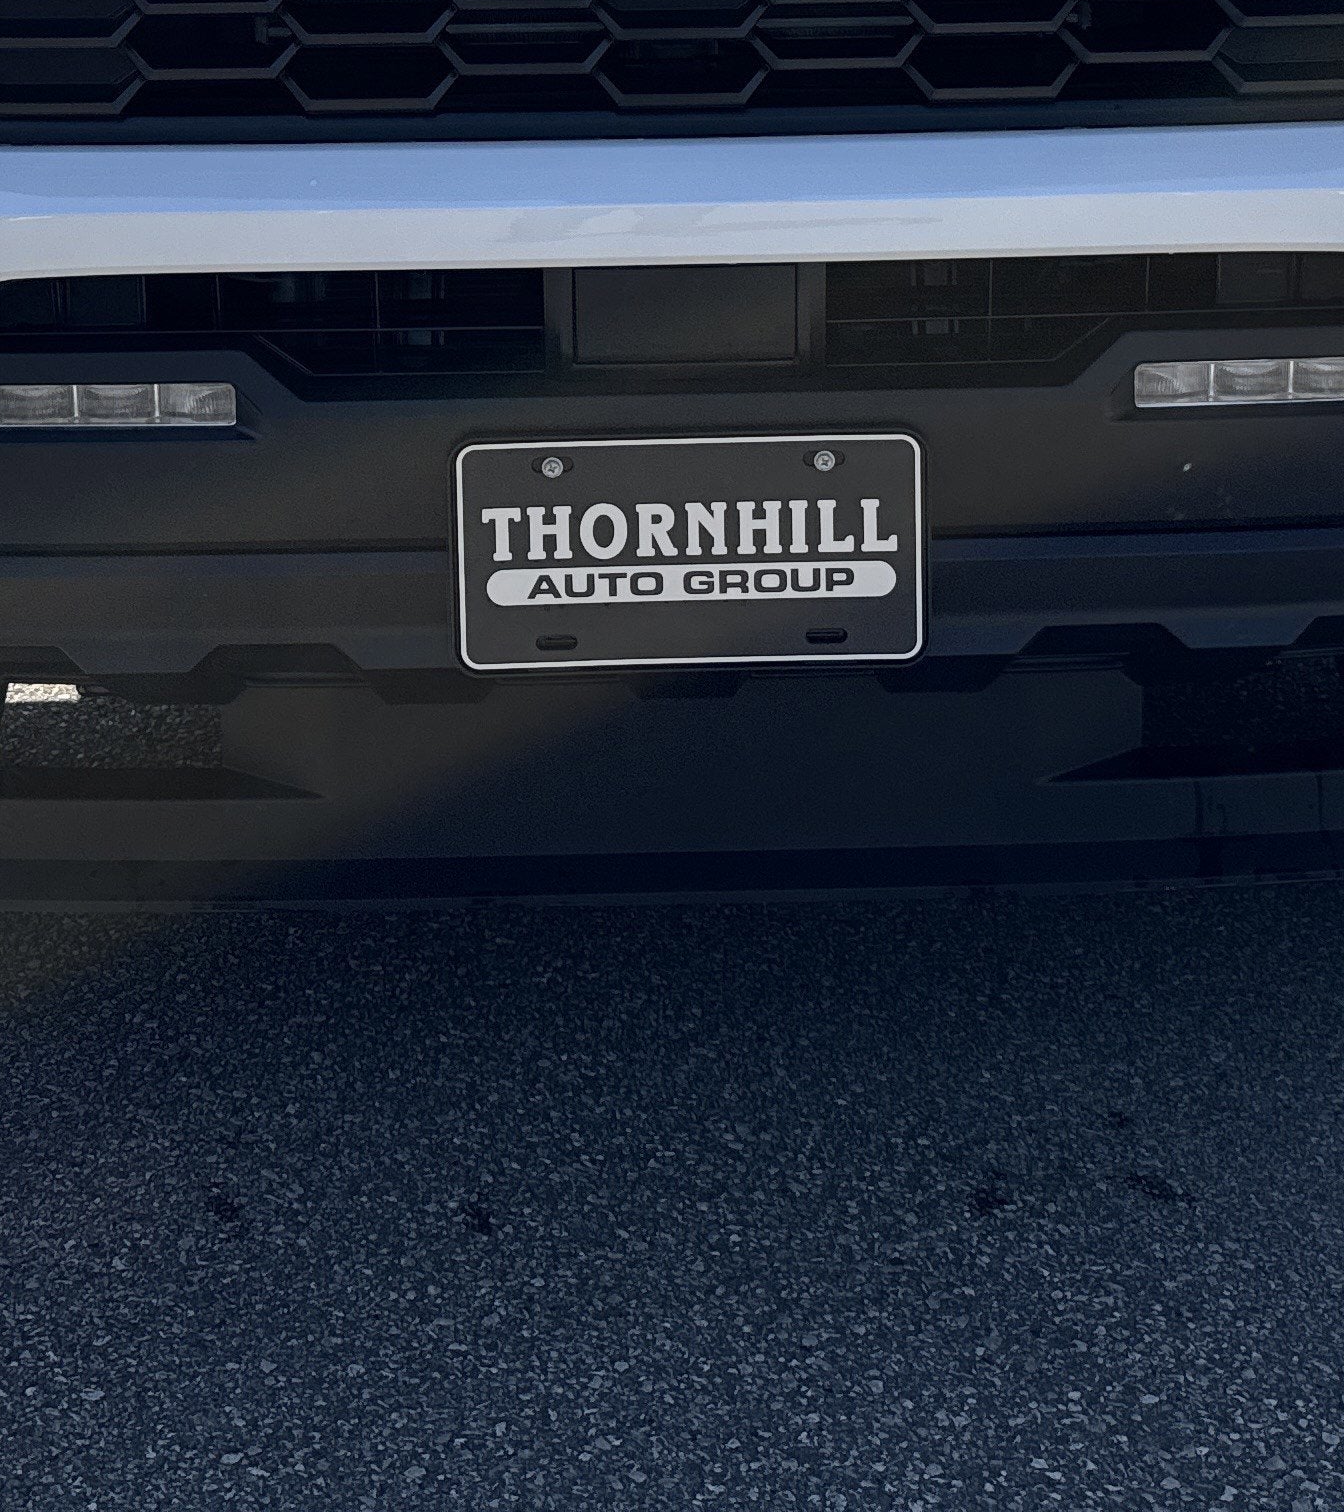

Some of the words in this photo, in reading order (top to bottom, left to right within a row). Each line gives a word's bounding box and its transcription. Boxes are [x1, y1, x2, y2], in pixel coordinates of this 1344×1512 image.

[481, 498, 898, 561] THORNHILL
[527, 571, 664, 600] AUTO
[683, 567, 854, 595] GROUP
